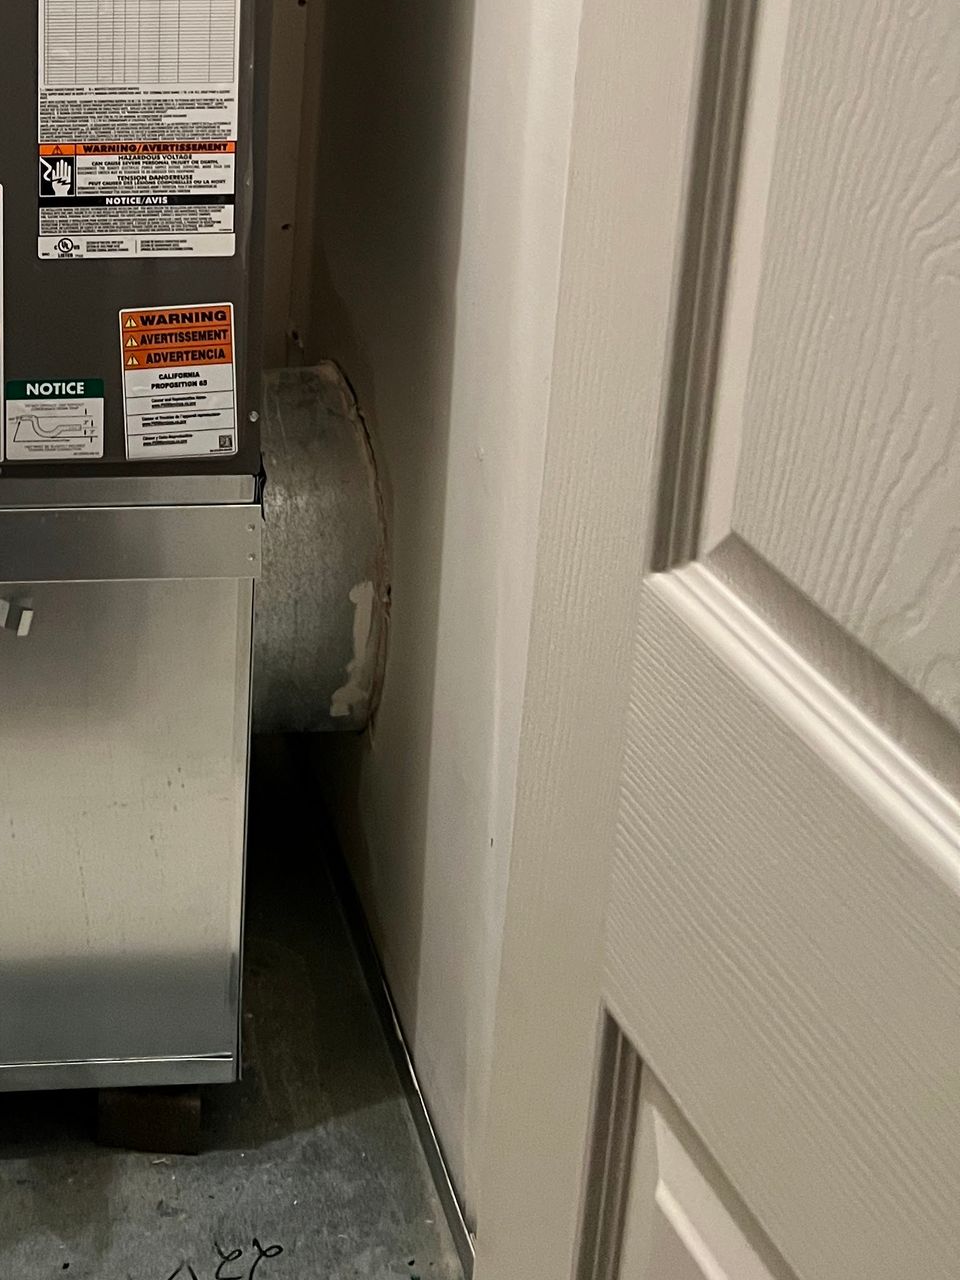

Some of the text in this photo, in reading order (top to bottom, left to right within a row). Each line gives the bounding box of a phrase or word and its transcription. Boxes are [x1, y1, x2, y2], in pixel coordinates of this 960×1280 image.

[83, 144, 228, 153] WARNING/AVERTISSEMENT
[105, 196, 168, 205] NOTICE/AVIS
[140, 311, 226, 326] WARNING
[140, 329, 228, 345] AVERTISSEMENT
[146, 348, 225, 364] ADVERTENCIA
[159, 372, 200, 380] CALIFORNIA
[26, 382, 84, 396] NOTICE
[151, 381, 197, 389] PROPOSITION
